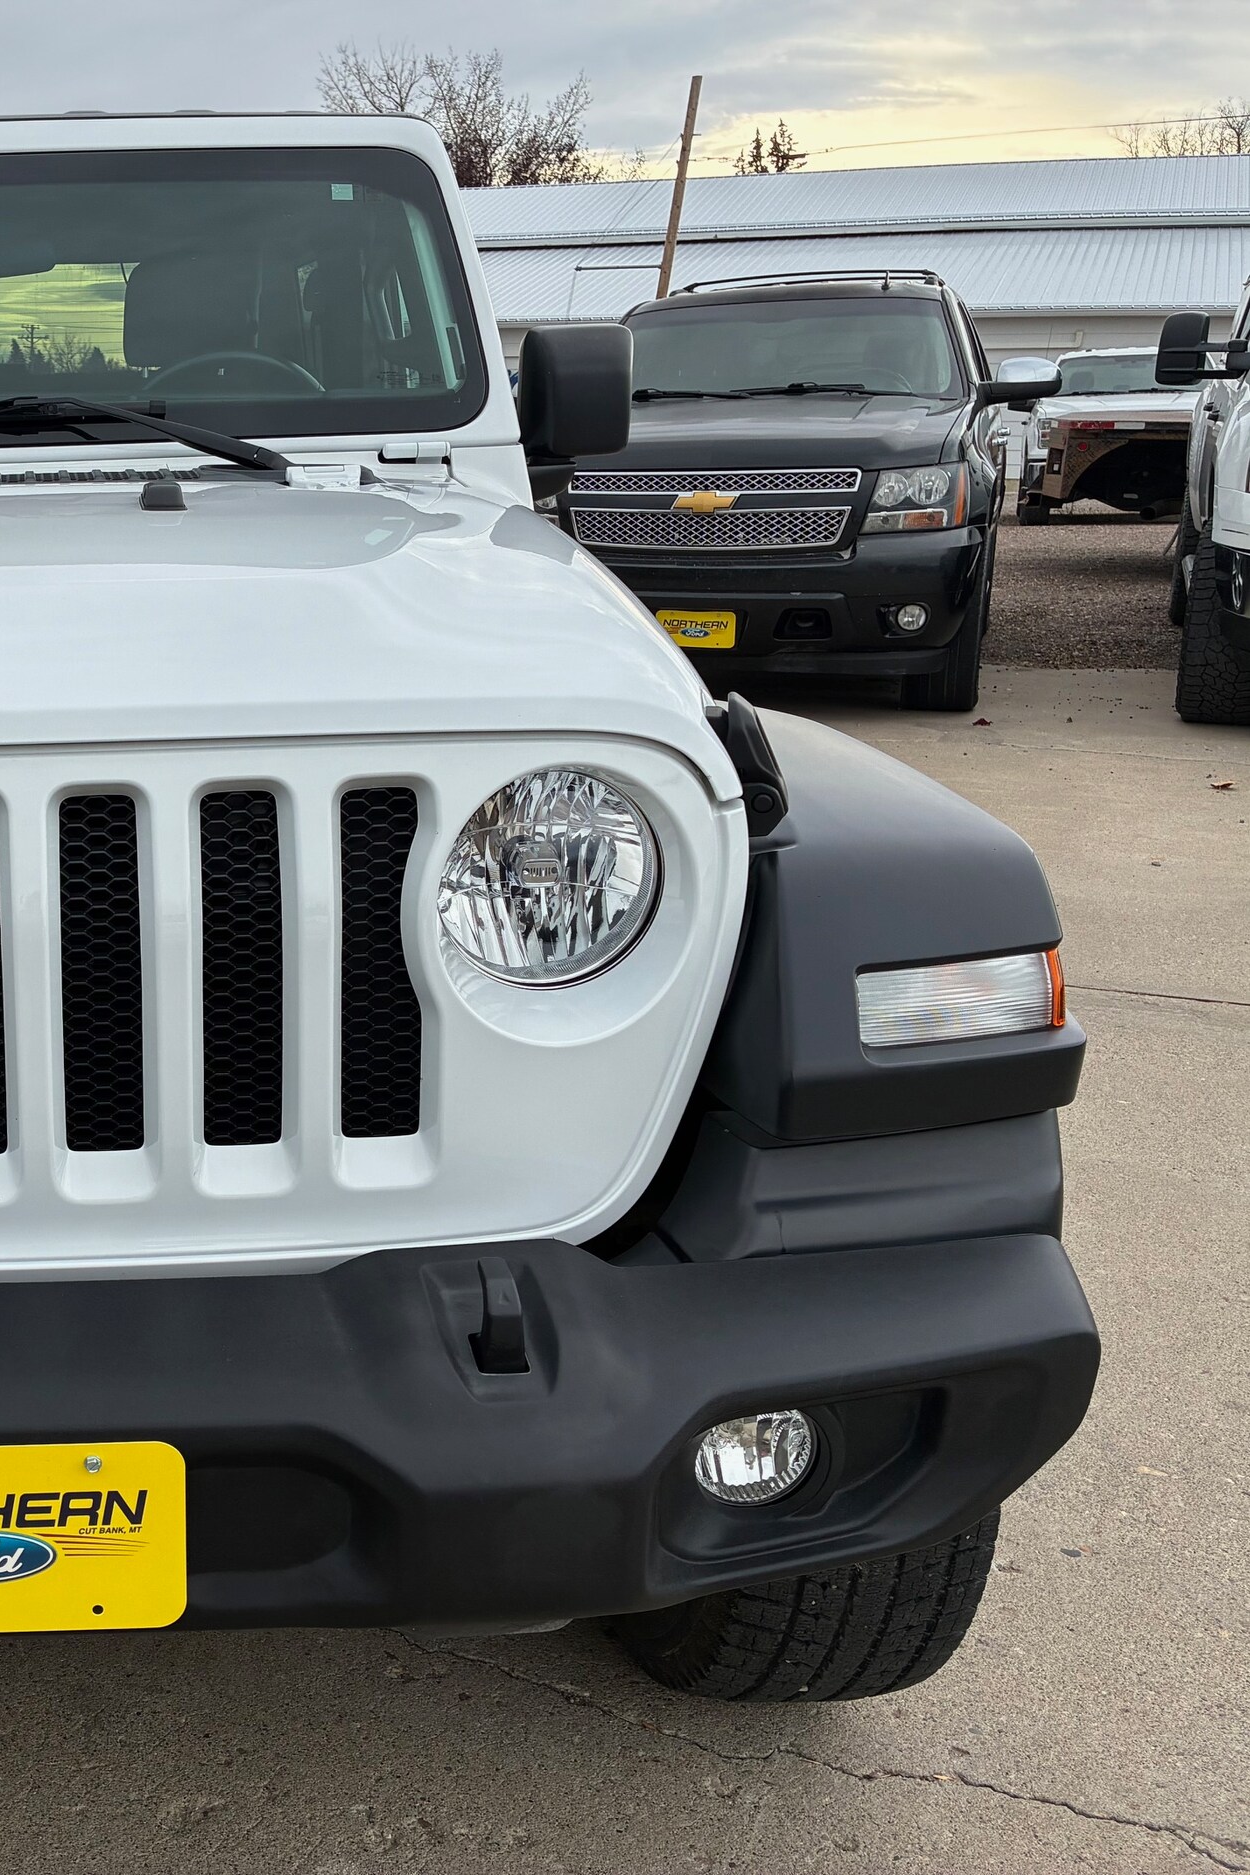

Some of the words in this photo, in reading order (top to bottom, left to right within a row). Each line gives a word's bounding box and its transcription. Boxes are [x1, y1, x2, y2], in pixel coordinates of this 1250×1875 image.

[663, 619, 729, 629] NORTHERN
[685, 628, 705, 637] Ford
[78, 1527, 98, 1535] CUT
[99, 1527, 127, 1535] BANK,
[129, 1526, 143, 1534] MT
